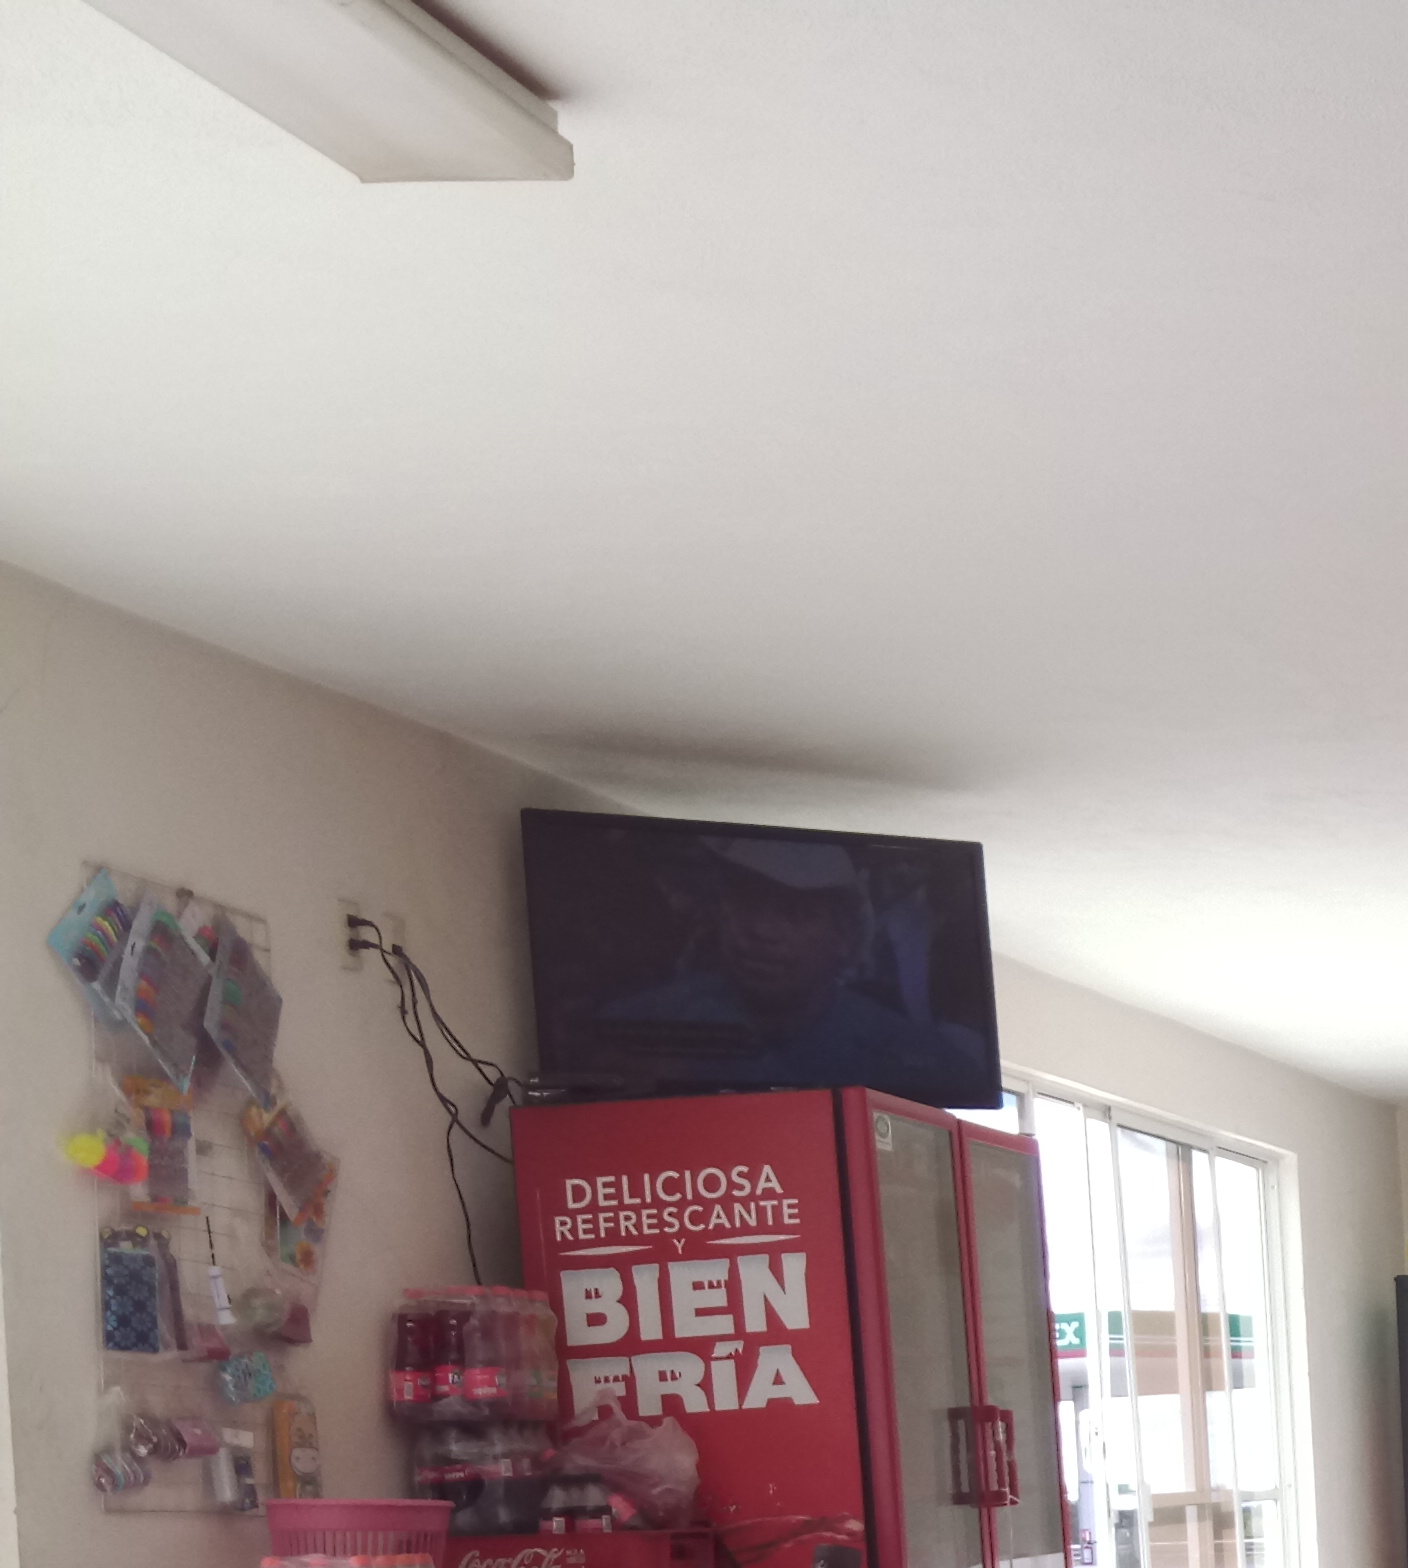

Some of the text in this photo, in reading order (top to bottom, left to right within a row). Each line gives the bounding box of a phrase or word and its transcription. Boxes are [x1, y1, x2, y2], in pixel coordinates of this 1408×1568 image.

[565, 1164, 784, 1210] DELICIOSA
[554, 1198, 801, 1241] REFRESCANTE
[672, 1237, 686, 1254] Y
[560, 1252, 811, 1347] BIEN
